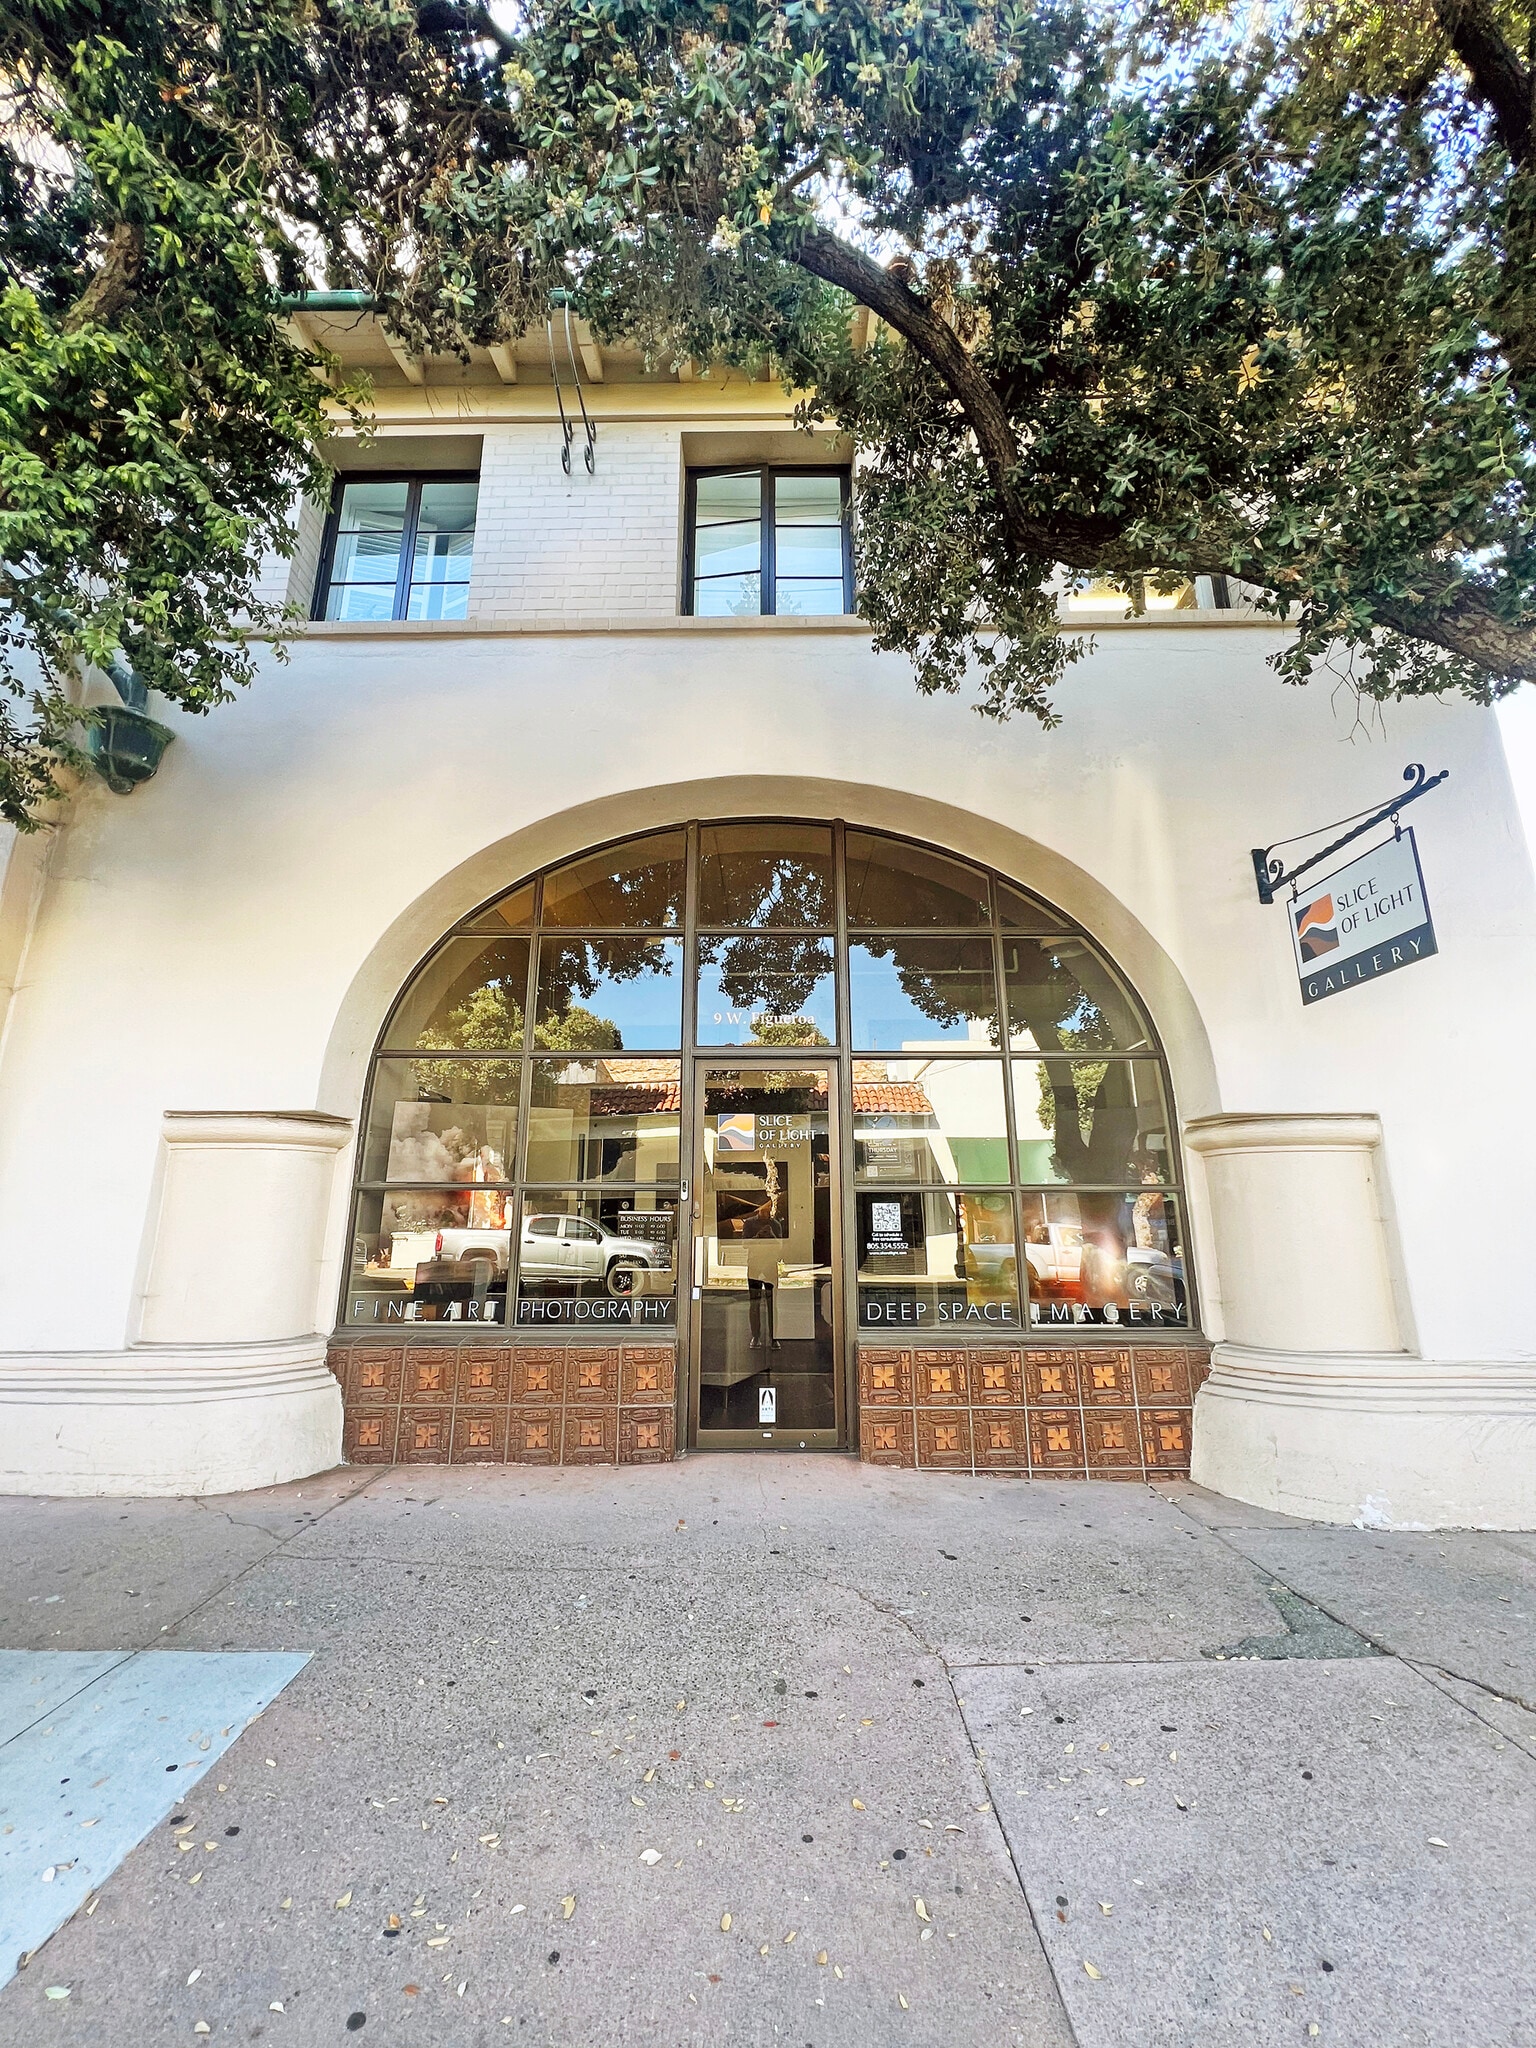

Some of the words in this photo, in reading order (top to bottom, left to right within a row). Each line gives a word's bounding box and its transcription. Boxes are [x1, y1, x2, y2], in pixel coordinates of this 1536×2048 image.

[1336, 877, 1379, 912] SLICE
[1341, 912, 1361, 934] OF
[1364, 884, 1415, 923] LIGHT
[1308, 937, 1423, 998] GALLERY
[713, 1012, 722, 1025] 9
[726, 1012, 747, 1025] W.
[751, 1011, 816, 1028] Figueroa
[759, 1115, 793, 1126] SLICE
[759, 1129, 776, 1141] OF
[779, 1129, 817, 1141] LIGHT
[866, 1242, 909, 1250] 805.354.5552
[354, 1300, 425, 1318] FINE
[443, 1300, 500, 1319] ART
[519, 1300, 671, 1319] PHOTOGRAPHY
[866, 1302, 927, 1321] DEEP
[938, 1302, 1013, 1321] SPACE
[1034, 1302, 1184, 1321] IMAGERY
